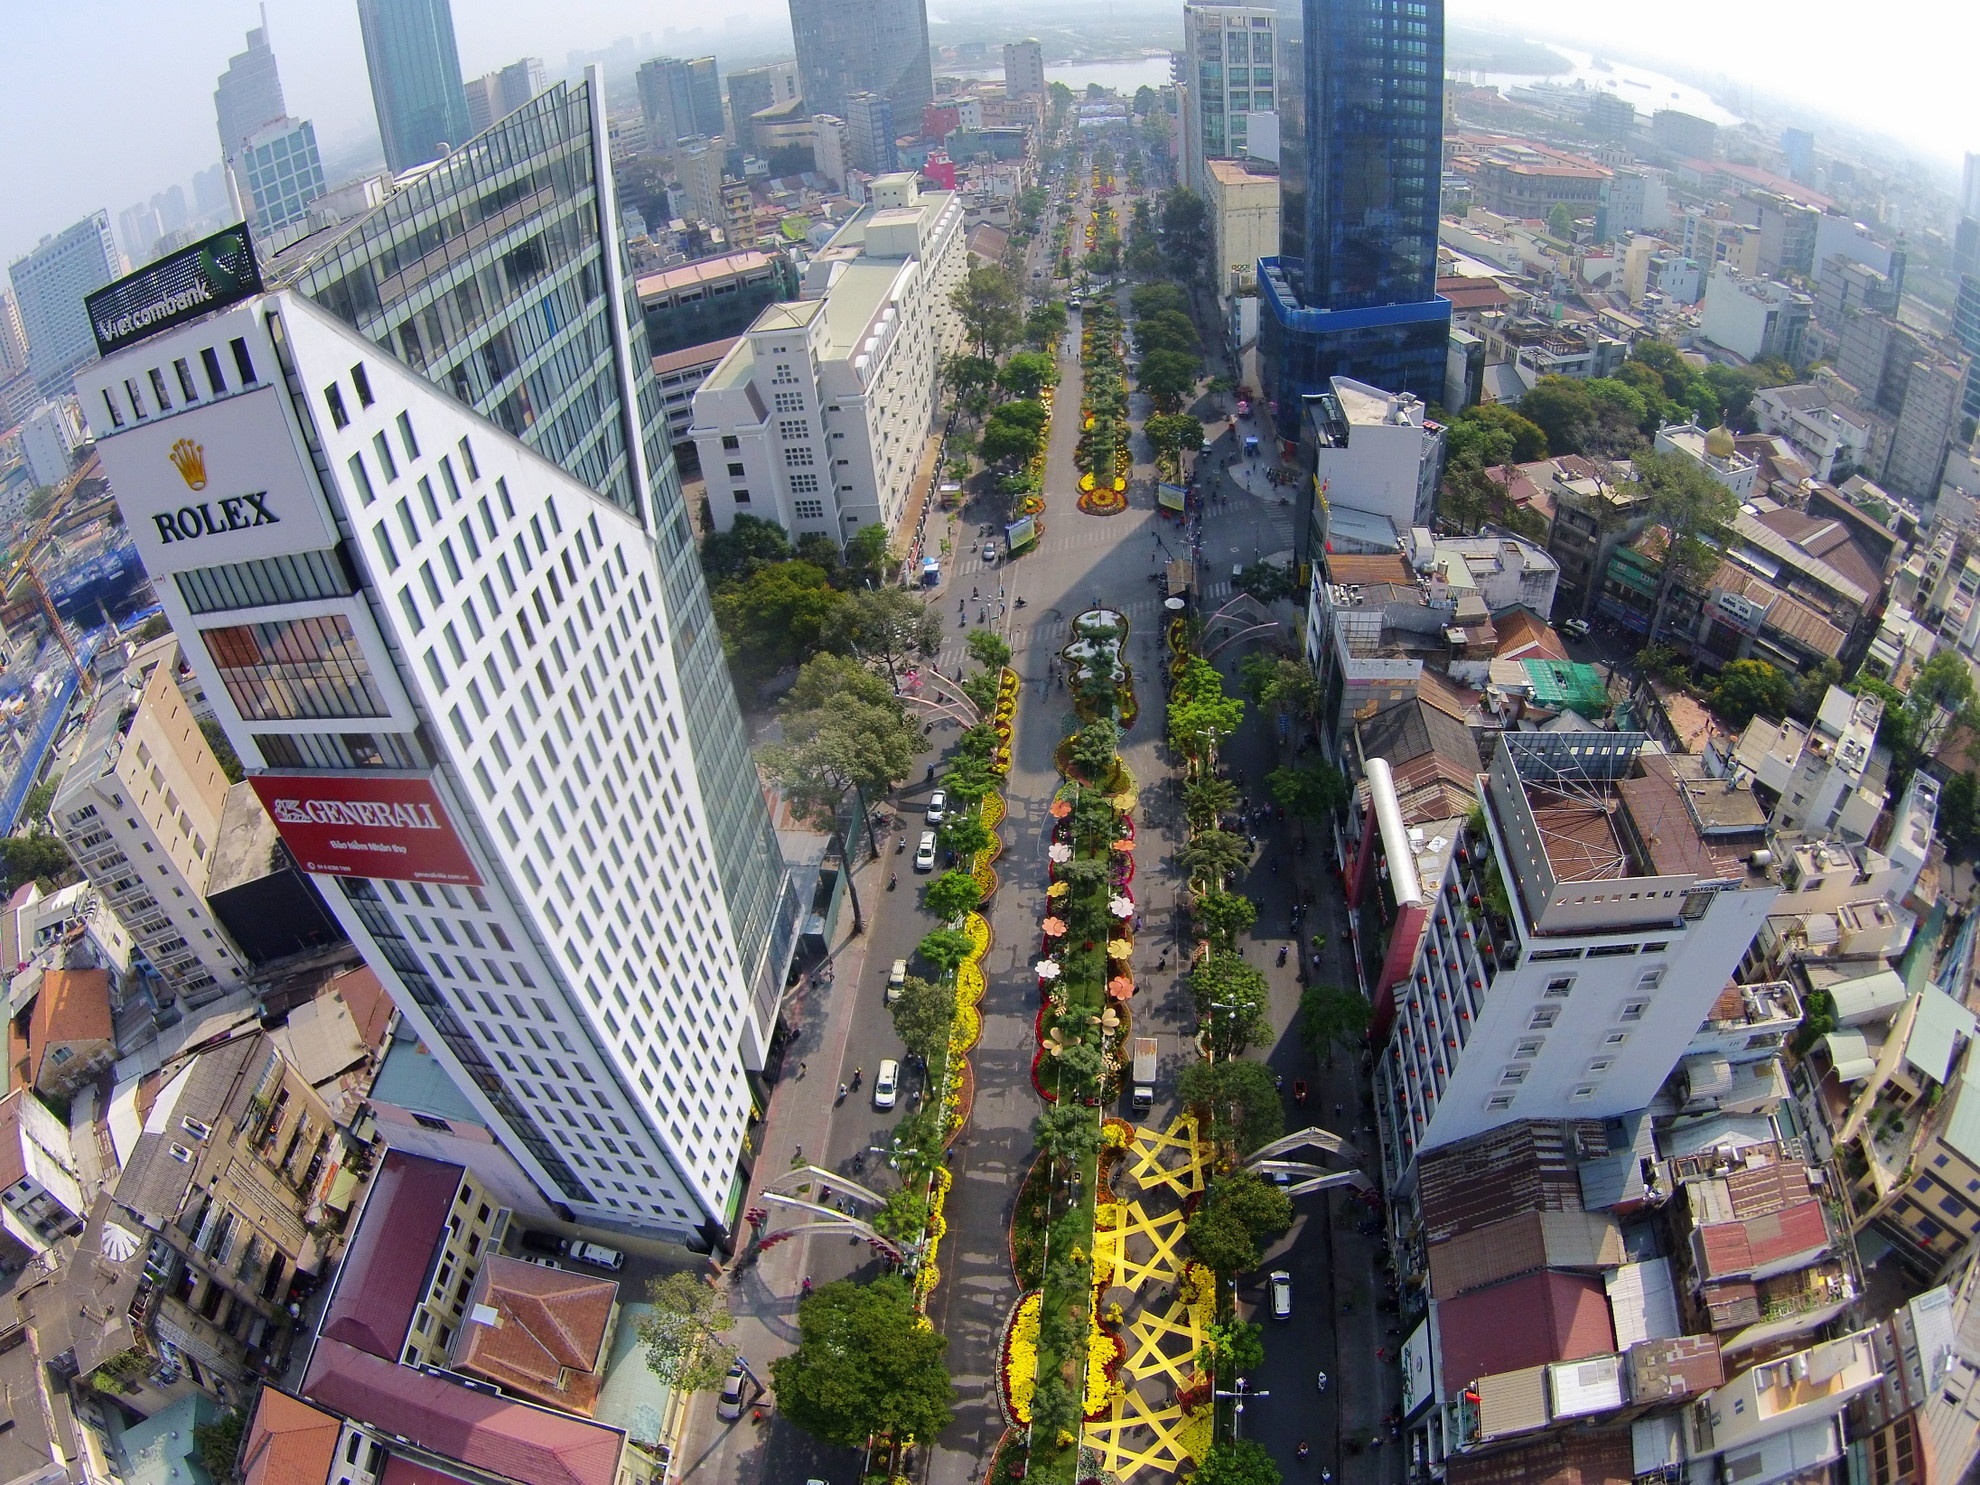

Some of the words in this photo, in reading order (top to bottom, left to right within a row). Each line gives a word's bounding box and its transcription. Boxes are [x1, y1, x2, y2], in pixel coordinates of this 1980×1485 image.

[99, 276, 213, 342] Vietcombank
[152, 491, 280, 544] ROLEX
[305, 799, 441, 830] GENERALI
